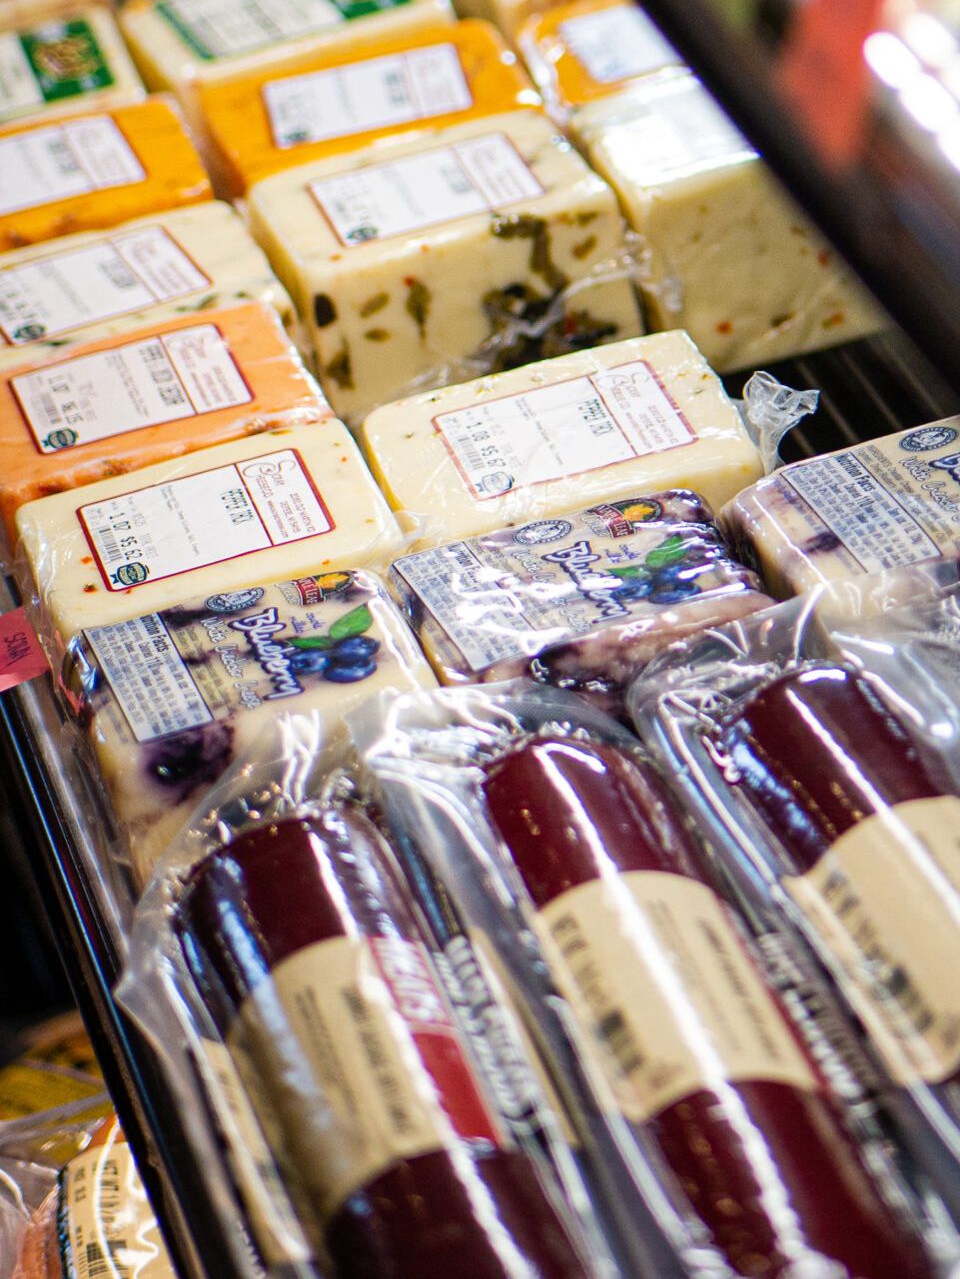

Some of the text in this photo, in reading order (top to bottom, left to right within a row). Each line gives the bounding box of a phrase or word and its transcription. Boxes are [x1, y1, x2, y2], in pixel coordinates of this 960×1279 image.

[220, 488, 248, 510] PEPPER
[108, 512, 130, 532] 1.07
[119, 536, 142, 559] $5.62
[541, 540, 632, 625] Blueerry
[228, 607, 305, 701] Blueberry
